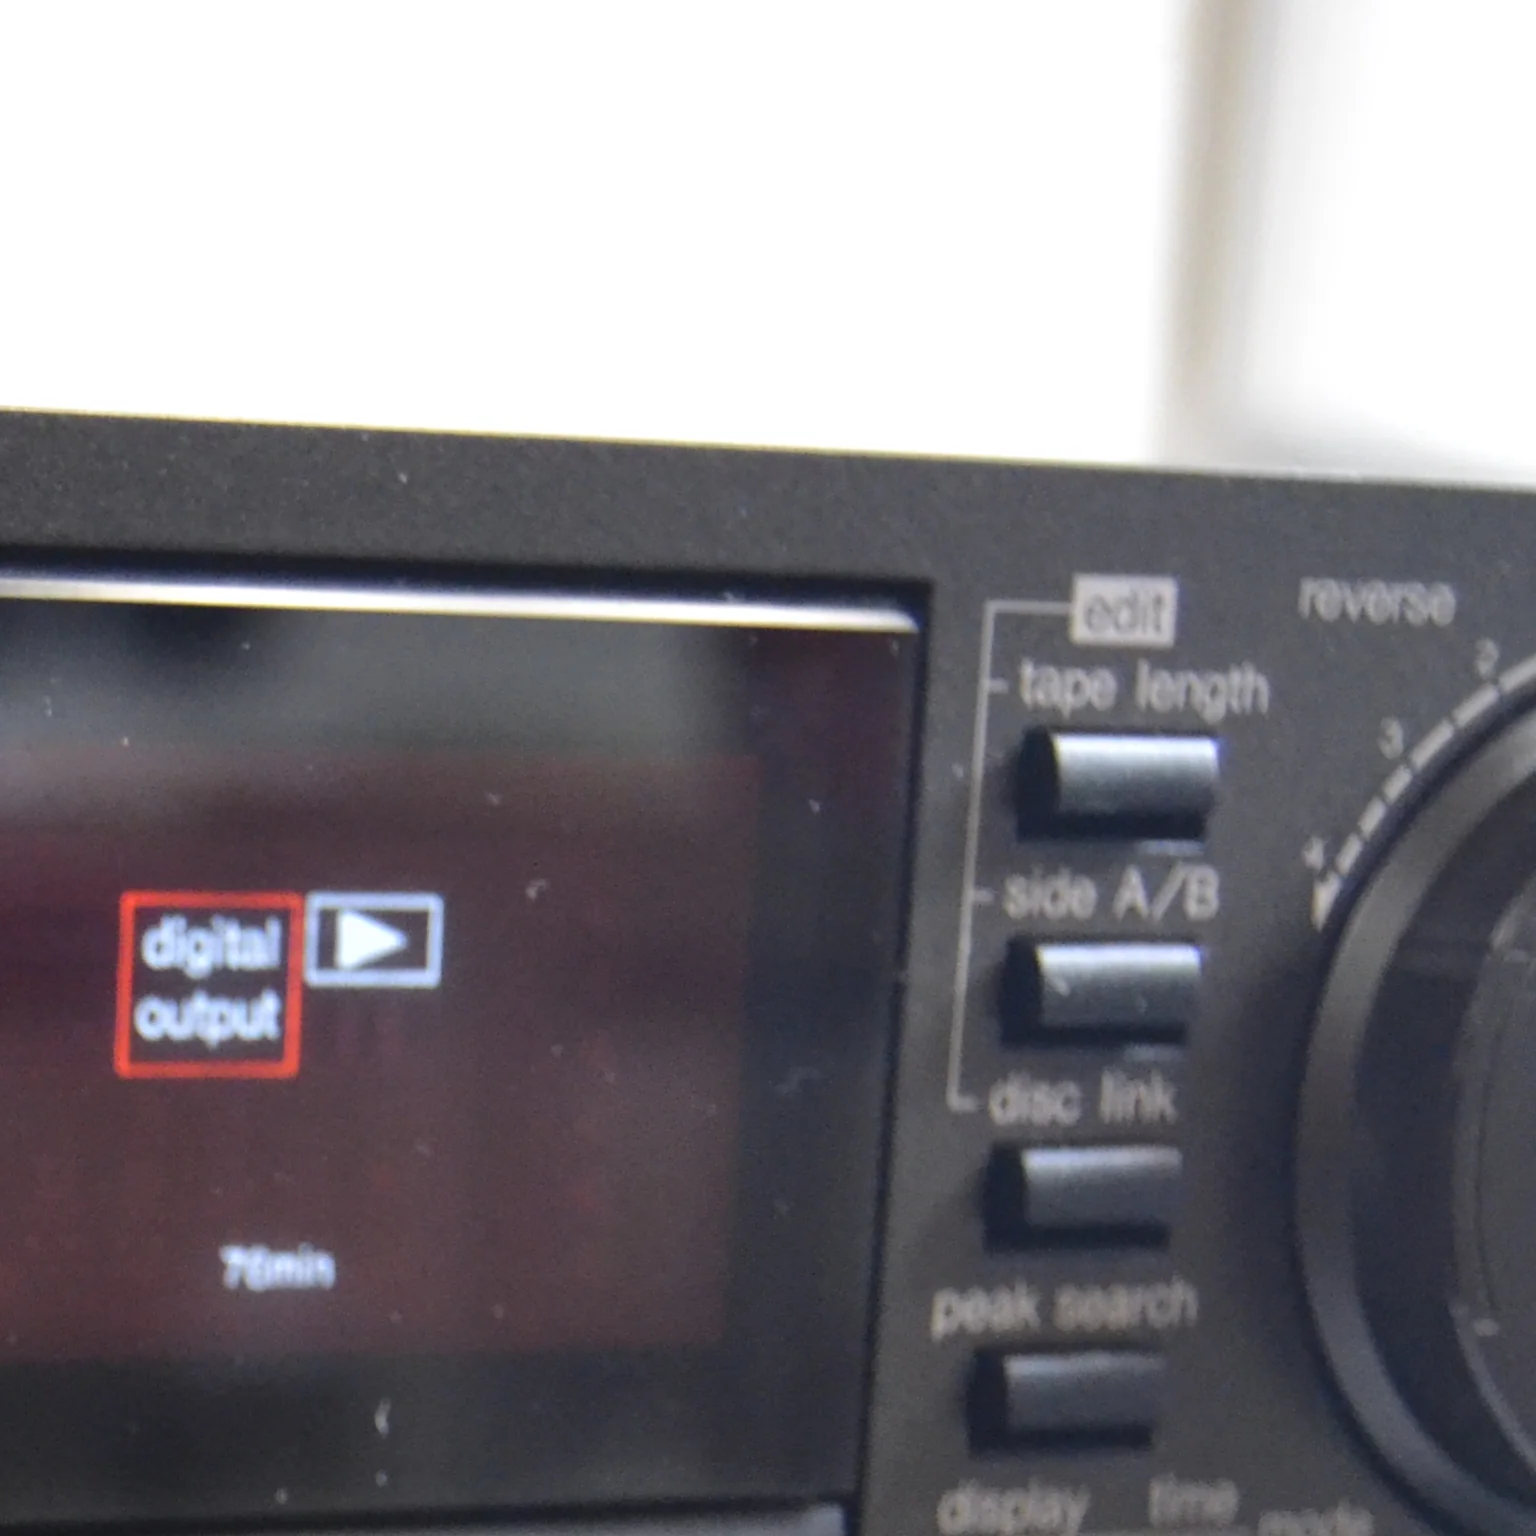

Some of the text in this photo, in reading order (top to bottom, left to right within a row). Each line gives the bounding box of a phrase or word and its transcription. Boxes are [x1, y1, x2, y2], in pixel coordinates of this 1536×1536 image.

[1082, 583, 1168, 636] edit
[1019, 659, 1271, 725] tape length
[1002, 863, 1220, 922] side A/B
[141, 915, 281, 977] digital
[133, 990, 281, 1047] output
